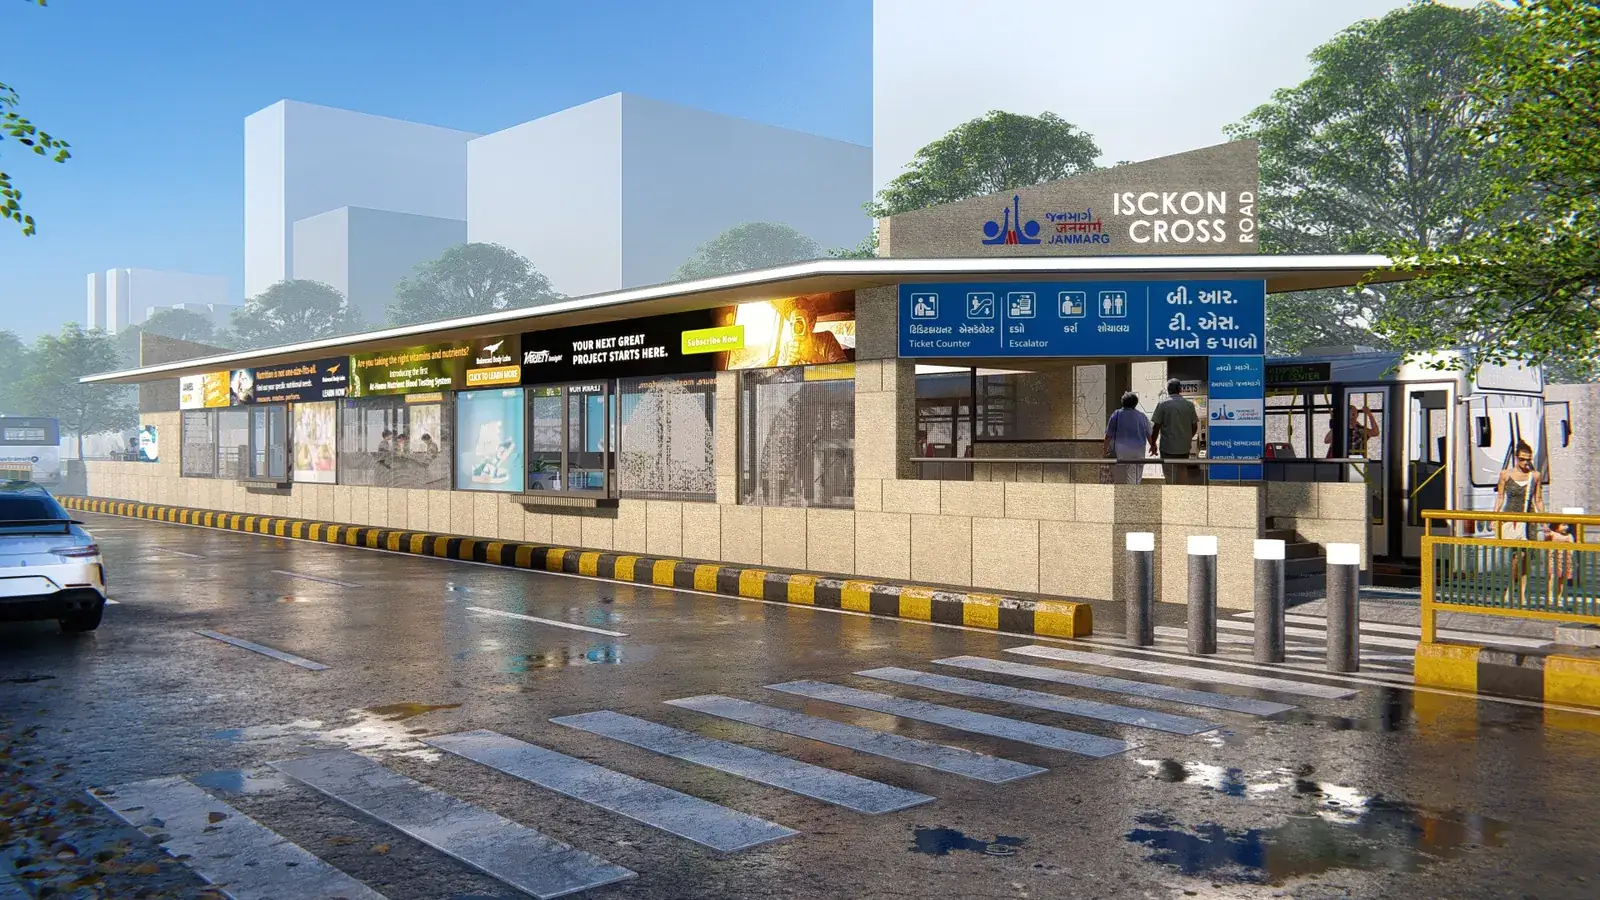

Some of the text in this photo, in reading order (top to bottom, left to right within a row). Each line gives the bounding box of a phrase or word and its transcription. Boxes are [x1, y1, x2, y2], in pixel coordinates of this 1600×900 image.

[1113, 191, 1226, 216] ISCKON
[1046, 208, 1093, 222] જનમાર્ગ
[1238, 191, 1254, 242] ROAD
[1055, 216, 1102, 233] जनमार्ग
[1128, 220, 1226, 244] CROSS
[1048, 234, 1110, 244] JANMARG
[1166, 286, 1238, 304] બી. આર.
[1168, 312, 1240, 331] ટી. એસ.
[572, 334, 645, 351] YOUR NEXT GREAT
[688, 335, 738, 347] Subscribe Now
[909, 340, 971, 348] Ticket Counter
[1009, 339, 1048, 348] Escalator
[374, 356, 388, 367] taking
[389, 355, 397, 364] the
[398, 354, 410, 365] right
[410, 352, 430, 361] vitamins
[432, 350, 441, 359] and
[442, 346, 470, 358] nutrients?
[524, 350, 550, 365] VARIETY
[572, 346, 668, 365] PROJECT STARTS HERE.
[418, 378, 434, 388] Testing
[435, 377, 451, 387] System
[469, 373, 481, 381] CLICK
[489, 371, 503, 380] LEARN
[504, 370, 518, 378] MORE
